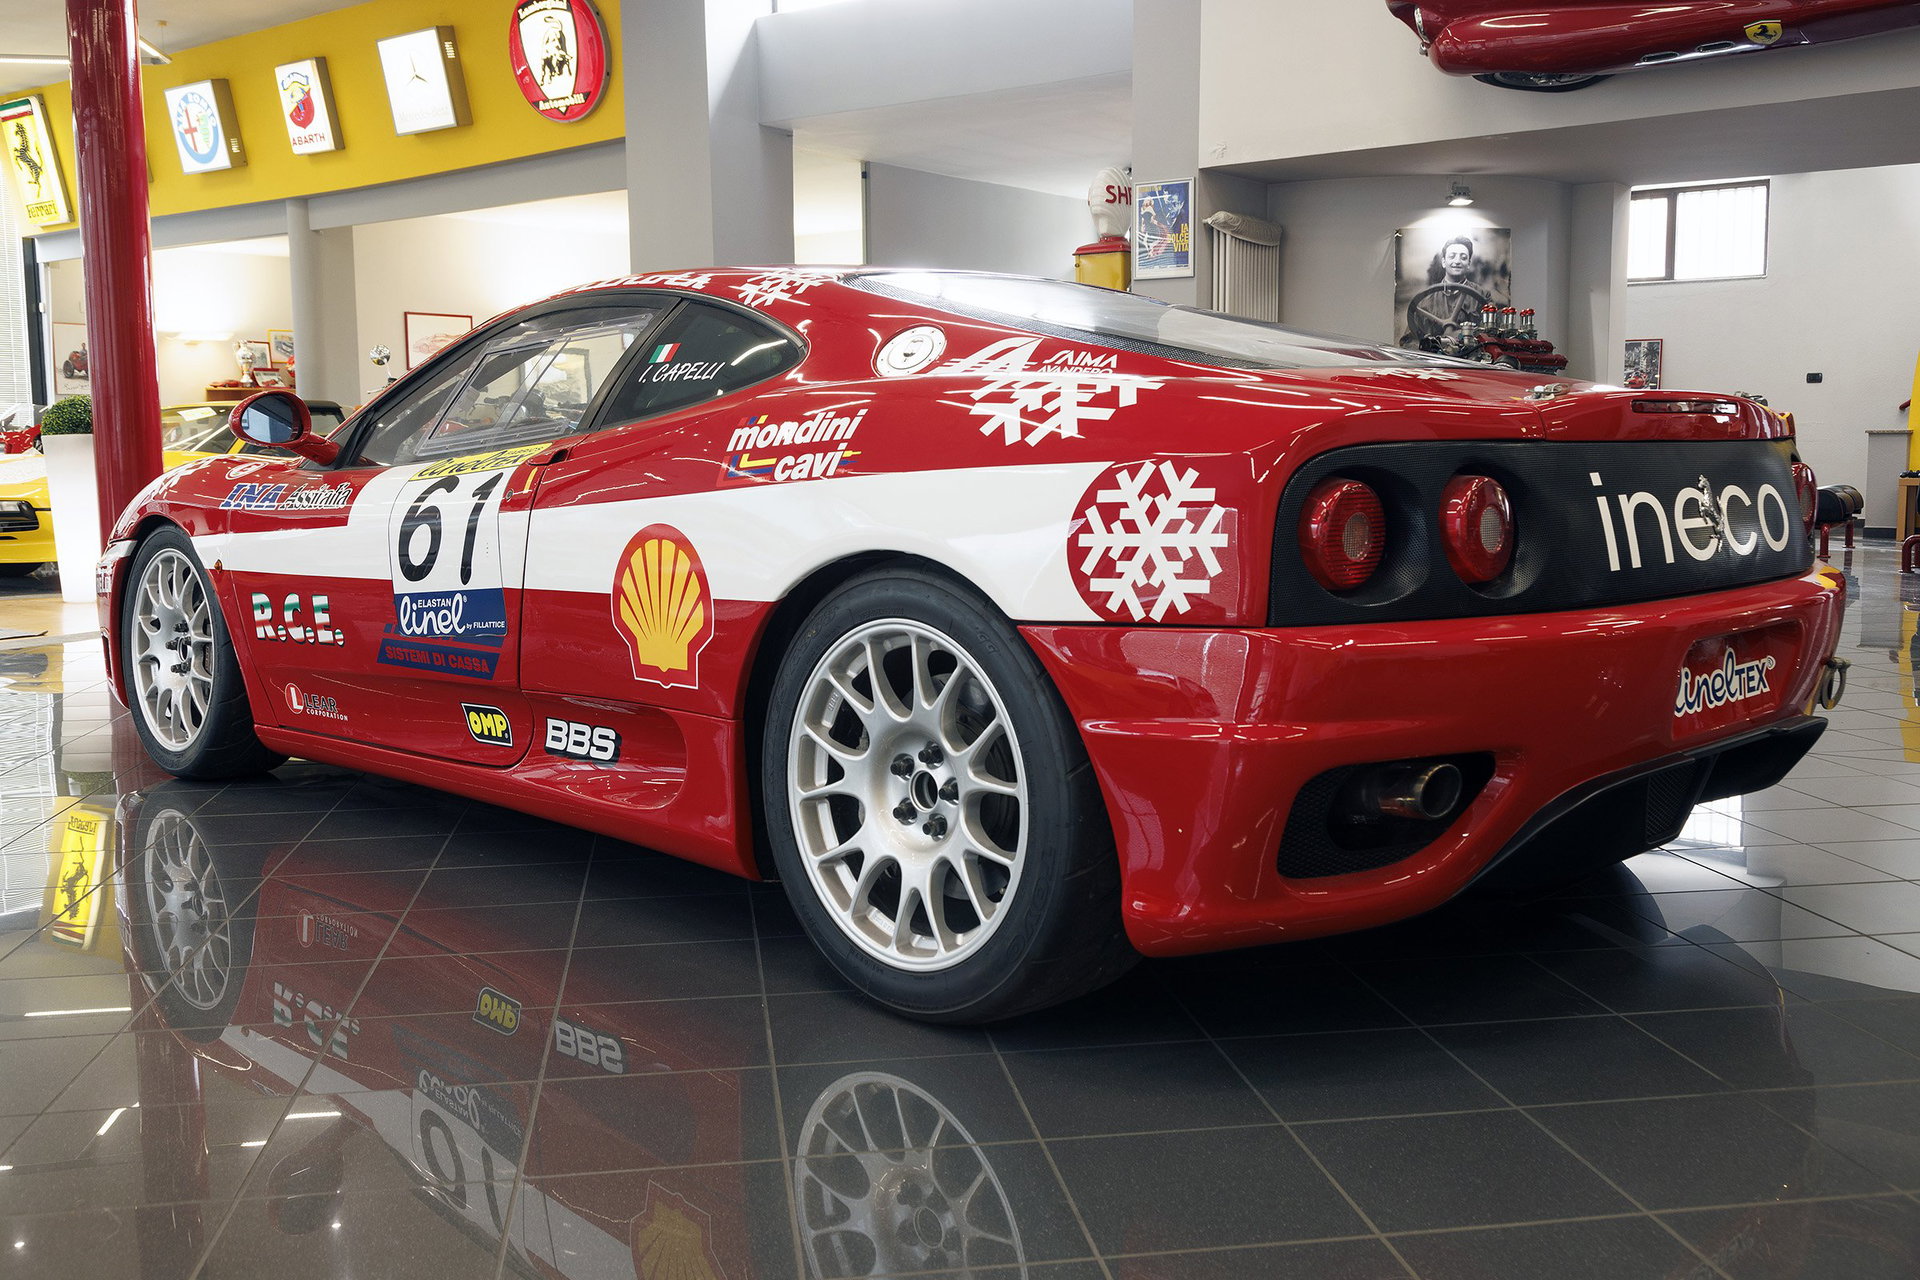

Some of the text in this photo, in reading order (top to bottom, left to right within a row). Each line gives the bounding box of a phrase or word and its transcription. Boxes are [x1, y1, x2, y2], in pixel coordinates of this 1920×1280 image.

[292, 132, 326, 146] ABARTH
[1105, 184, 1132, 206] SH
[26, 200, 58, 219] Ferrari
[1173, 242, 1189, 252] VITA
[1042, 349, 1118, 369] SAIMA
[652, 362, 726, 383] CAPELLI
[726, 408, 869, 452] mondini
[773, 442, 848, 482] cavi
[219, 482, 289, 510] INA
[398, 472, 504, 586] 61
[1589, 472, 1790, 572] ineco
[400, 592, 466, 635] linel
[417, 598, 452, 609] ELASTAN
[251, 592, 345, 647] R.C.E.
[473, 621, 506, 629] FILLATTICE
[384, 645, 491, 673] SISTEMI DI CASSA
[304, 693, 338, 713] LEAR
[306, 708, 349, 721] CORPORATION
[468, 711, 508, 738] OMP
[545, 717, 617, 761] BBS
